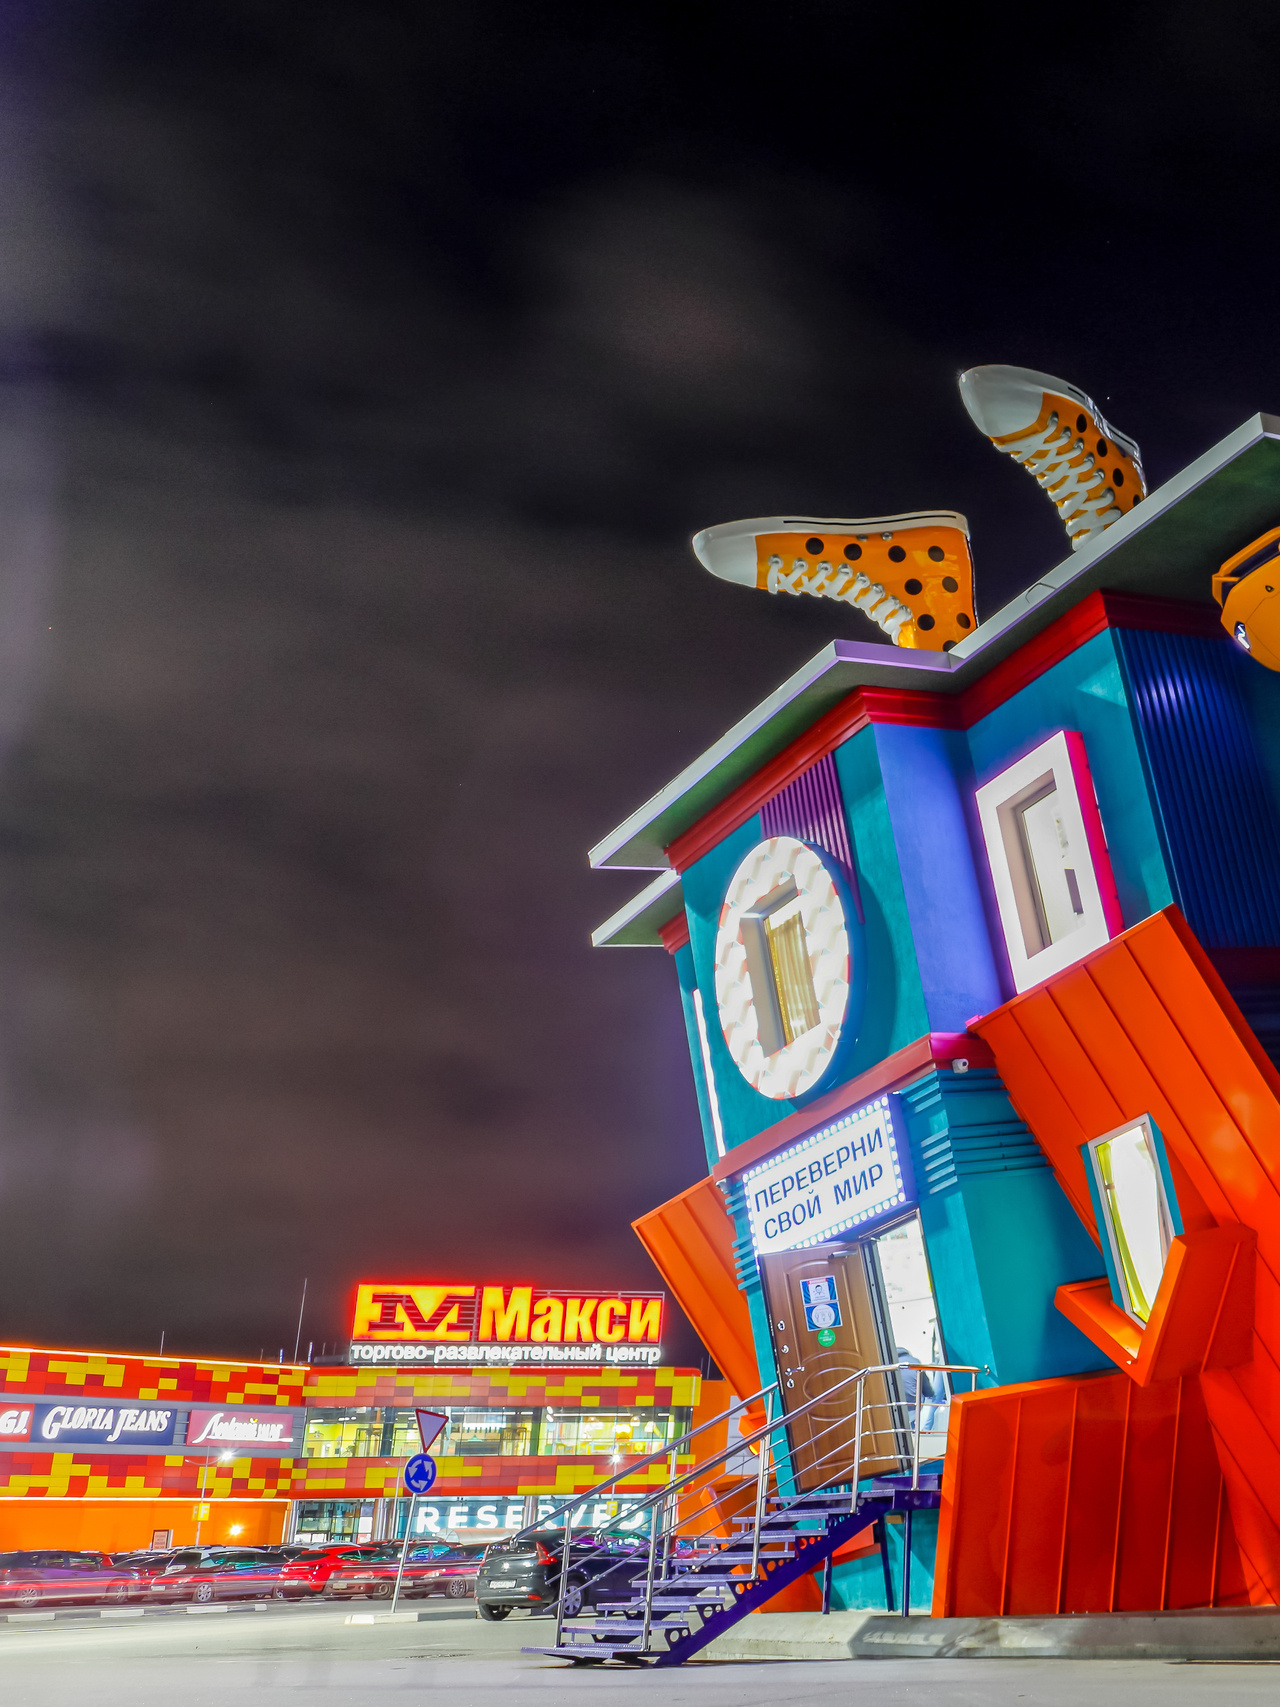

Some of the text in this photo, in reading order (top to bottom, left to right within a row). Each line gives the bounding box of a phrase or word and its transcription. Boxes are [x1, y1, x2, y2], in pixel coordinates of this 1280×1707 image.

[754, 1127, 883, 1213] ПЕРЕВЕРНИ
[764, 1163, 883, 1240] СВОЙ МИР
[478, 1286, 661, 1343] Макси
[351, 1343, 661, 1364] торгово-развлекательный центр
[42, 1406, 114, 1439] GLORIA
[106, 1409, 171, 1442] JEANS
[200, 1505, 209, 1518] F
[607, 1503, 617, 1515] F
